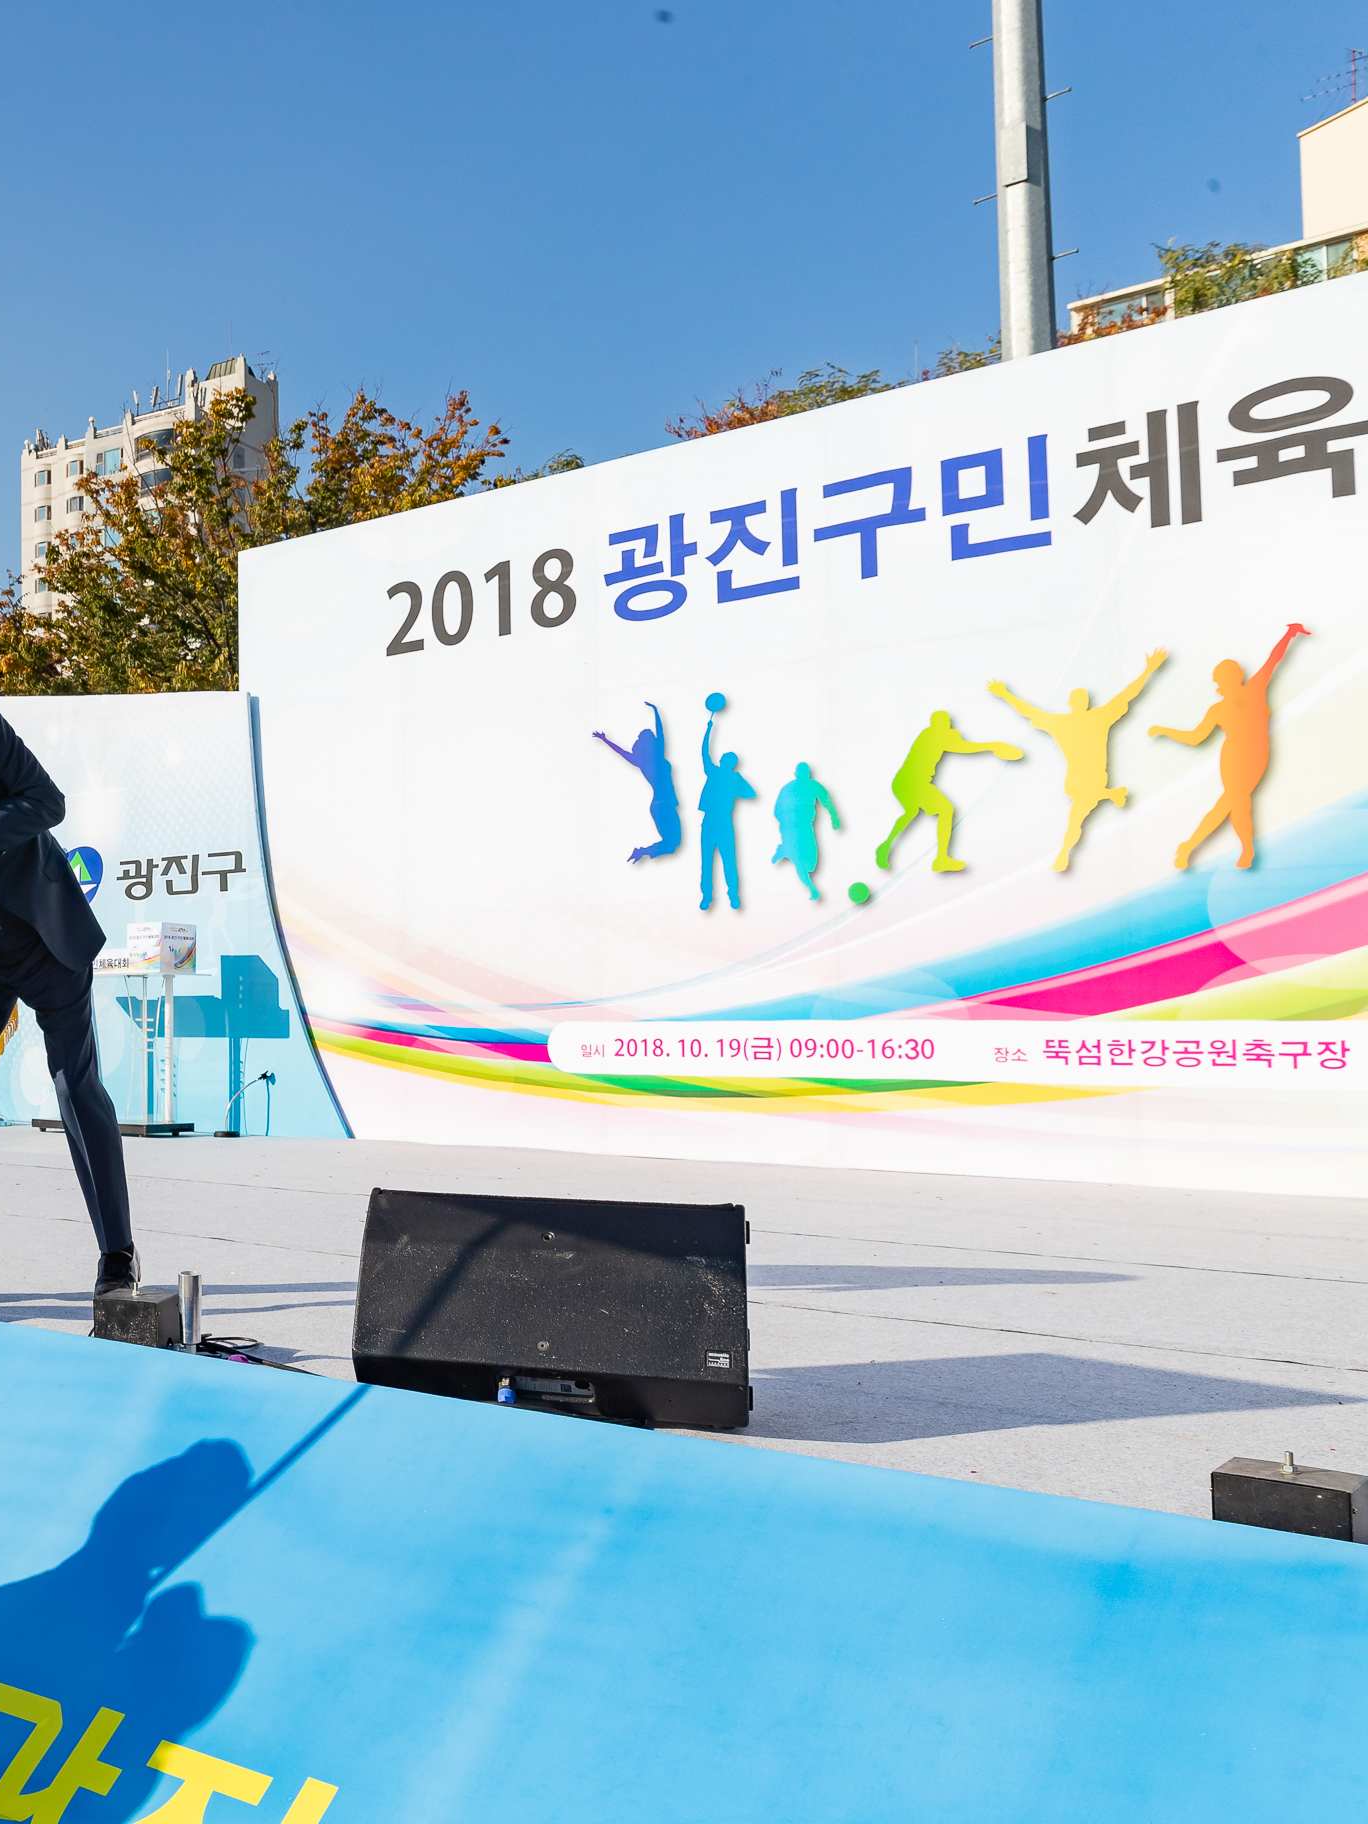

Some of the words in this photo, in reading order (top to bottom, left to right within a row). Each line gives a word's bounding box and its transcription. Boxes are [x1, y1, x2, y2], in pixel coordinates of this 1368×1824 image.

[385, 548, 577, 657] 2018
[116, 850, 247, 901] 광진구
[581, 1044, 605, 1058] 일시
[614, 1038, 670, 1058] 2018.
[677, 1038, 709, 1058] 10.
[716, 1037, 782, 1062] 19(금)
[789, 1038, 935, 1061] 09:00-16:30
[994, 1047, 1028, 1063] 장소
[1042, 1039, 1351, 1070] 뚝섬한강공원축구장
